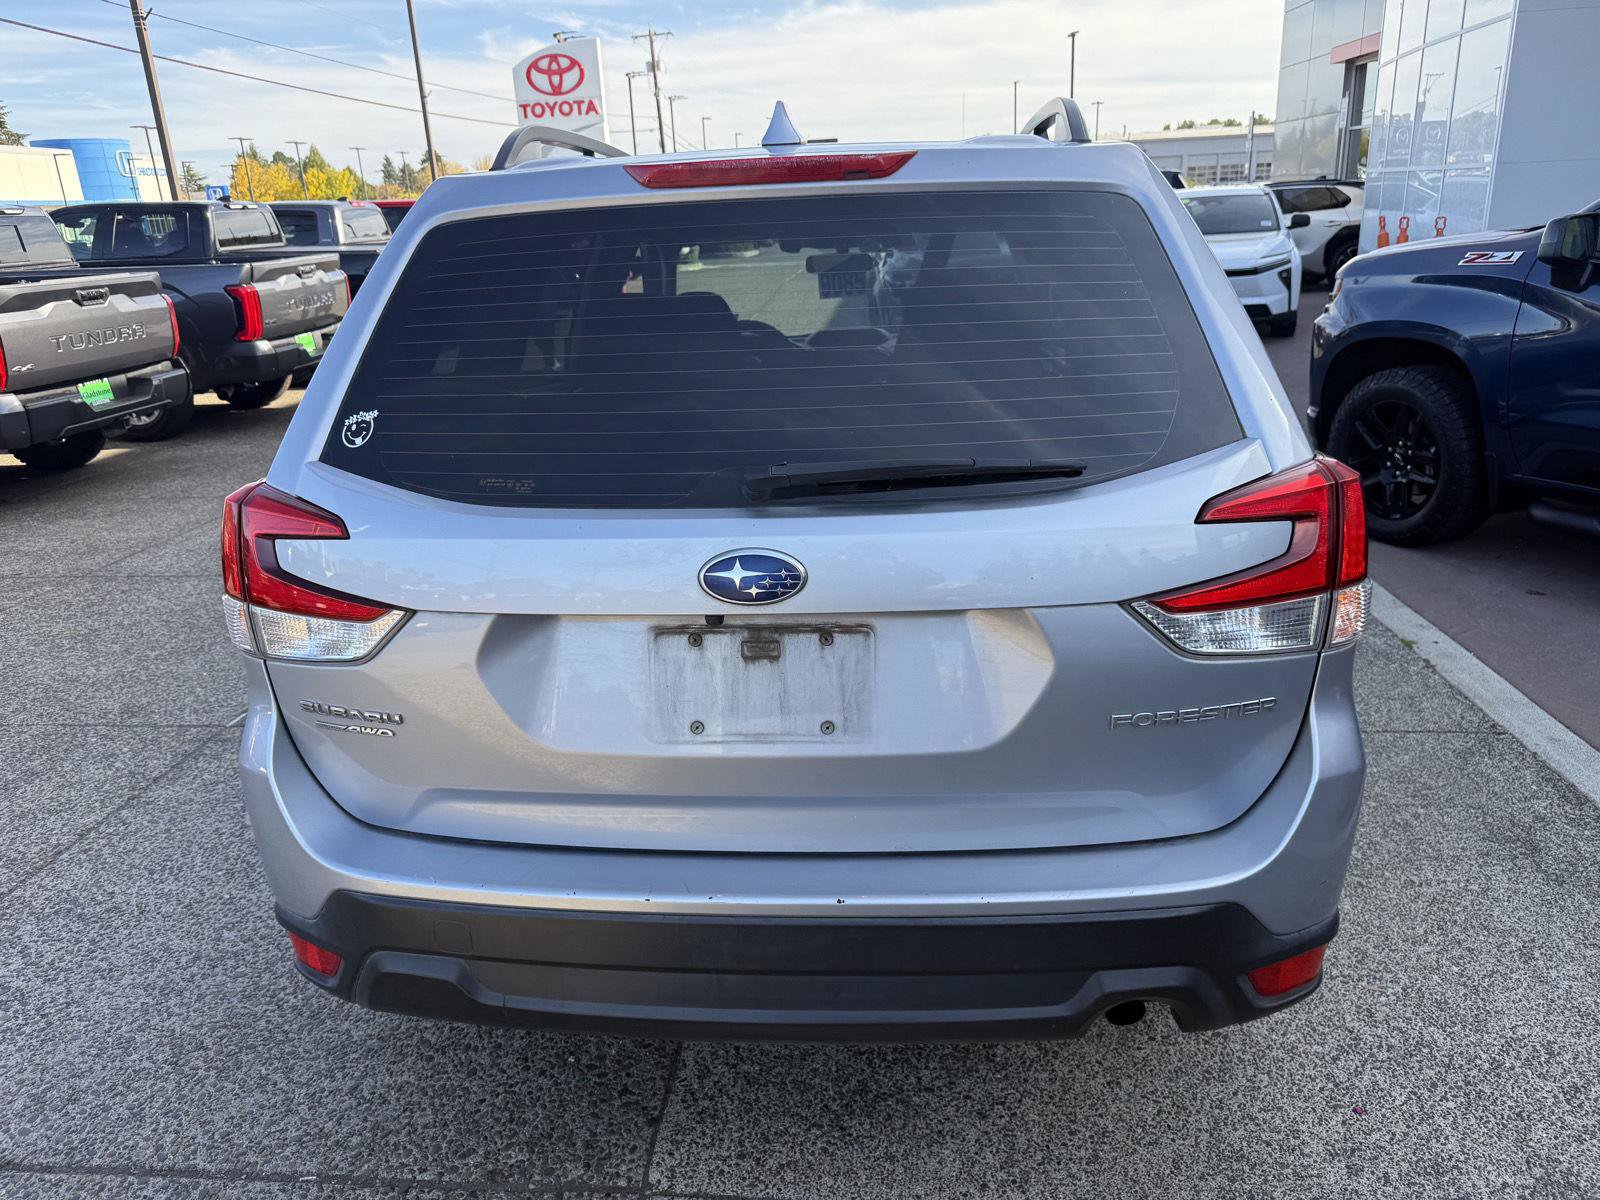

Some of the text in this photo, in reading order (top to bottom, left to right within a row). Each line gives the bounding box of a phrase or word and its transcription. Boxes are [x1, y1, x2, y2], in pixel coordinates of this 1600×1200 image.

[518, 99, 600, 120] TOYOTA
[49, 322, 147, 353] TUNDRA
[298, 698, 405, 725] SUBARU
[1109, 696, 1278, 729] FORESTER
[344, 724, 396, 738] AWD
